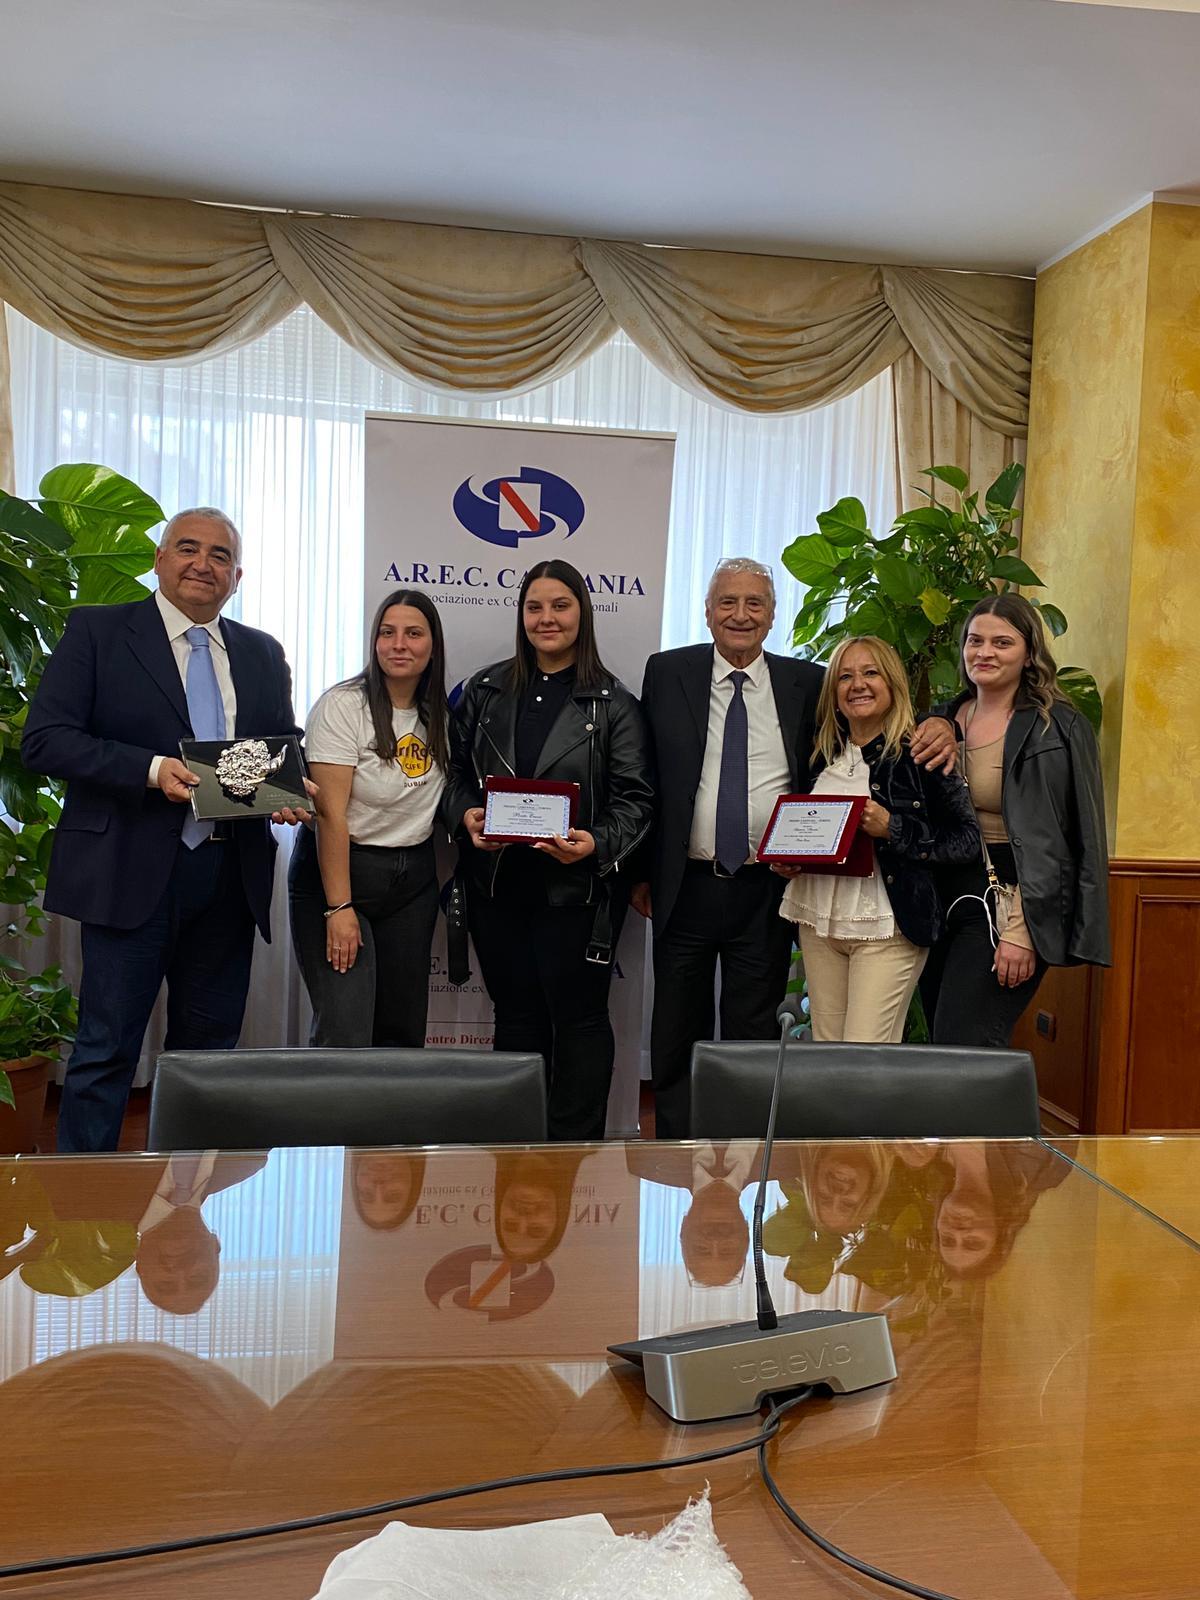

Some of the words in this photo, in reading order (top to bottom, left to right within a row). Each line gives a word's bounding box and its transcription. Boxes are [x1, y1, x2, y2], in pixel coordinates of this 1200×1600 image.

[384, 561, 489, 588] A.R.E.C.
[431, 592, 484, 606] ociazione
[487, 598, 500, 606] ex
[592, 602, 618, 613] onali
[430, 982, 468, 993] iazione
[471, 985, 485, 993] ex
[426, 1034, 457, 1045] entro
[460, 1034, 495, 1045] Direzi
